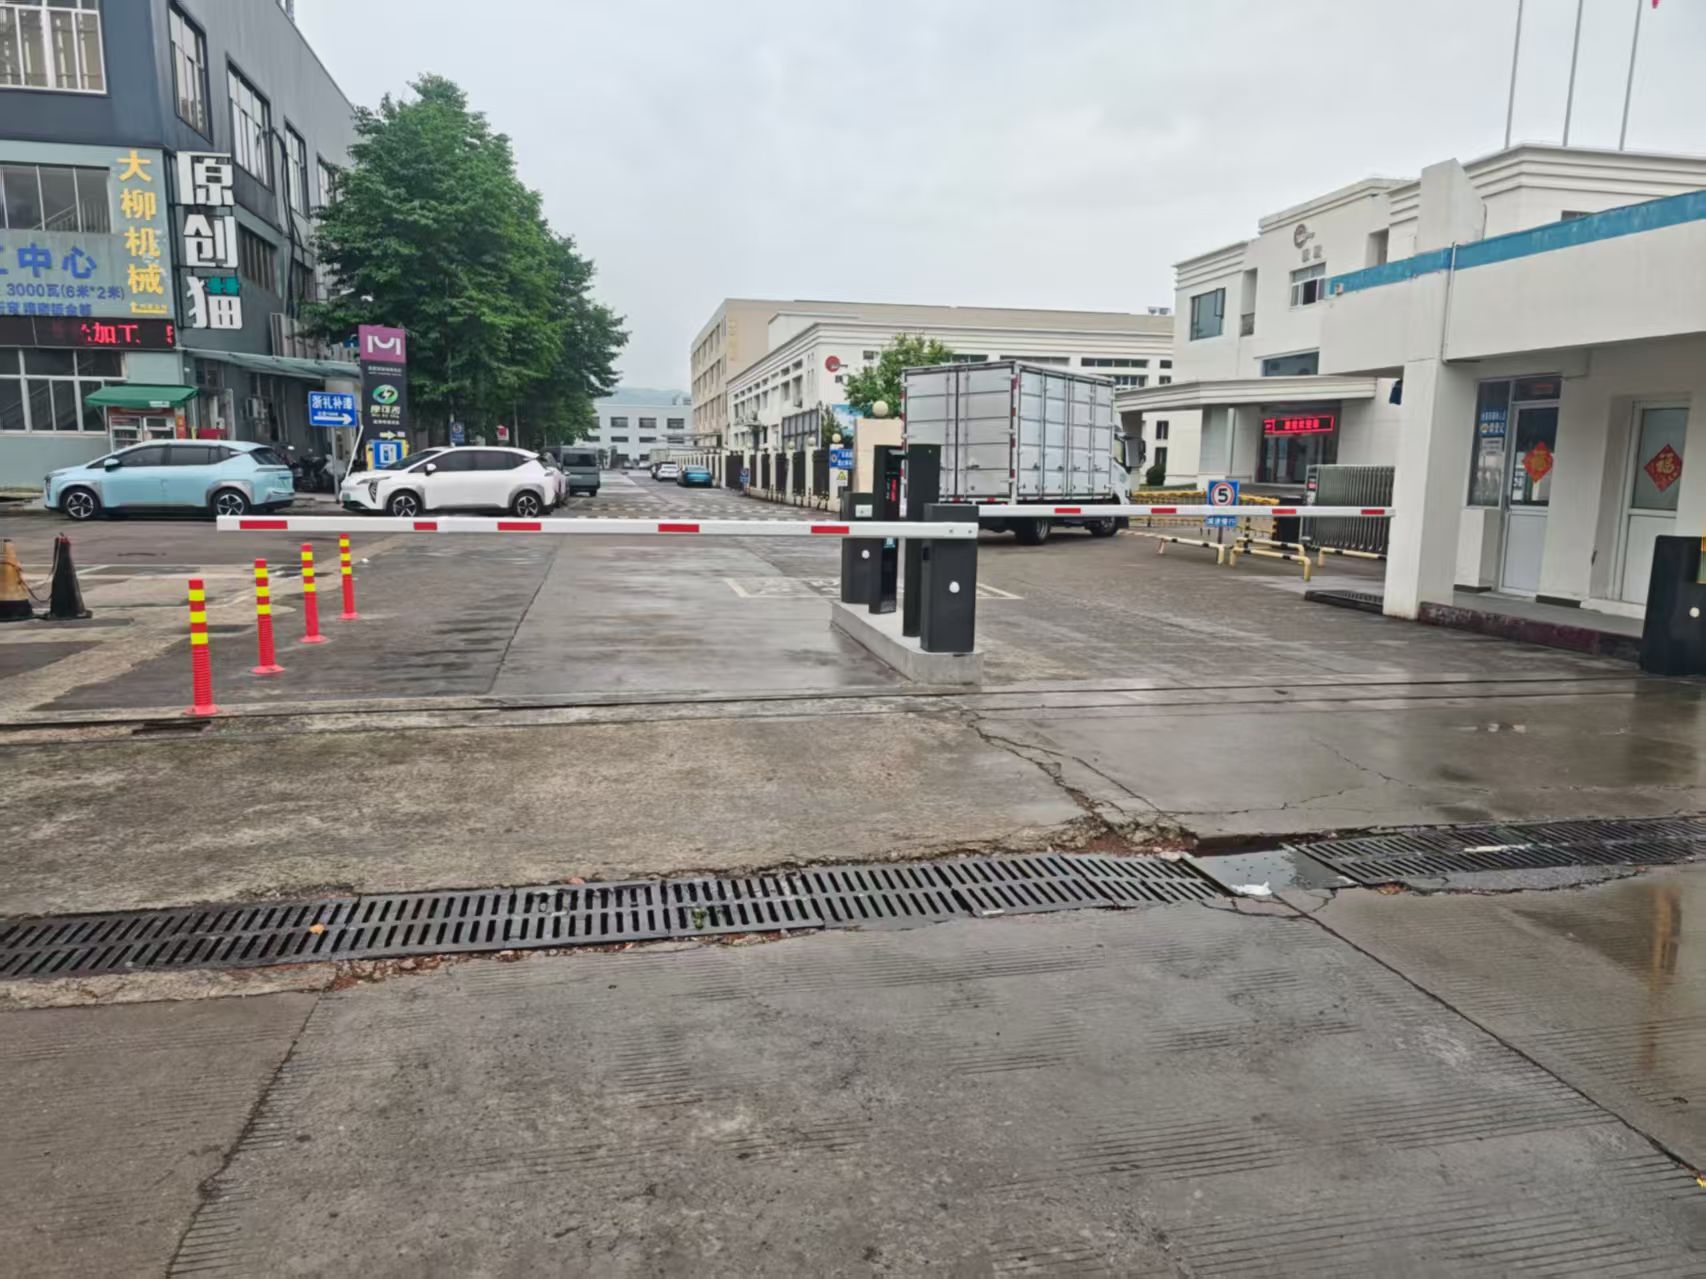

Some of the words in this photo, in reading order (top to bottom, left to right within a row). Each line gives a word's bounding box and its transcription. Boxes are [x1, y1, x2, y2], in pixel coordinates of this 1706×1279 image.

[117, 149, 164, 294] 大柳机械
[176, 151, 243, 329] 原创猫
[0, 242, 97, 278] 中心
[1656, 453, 1675, 474] 福
[1218, 487, 1229, 503] 5
